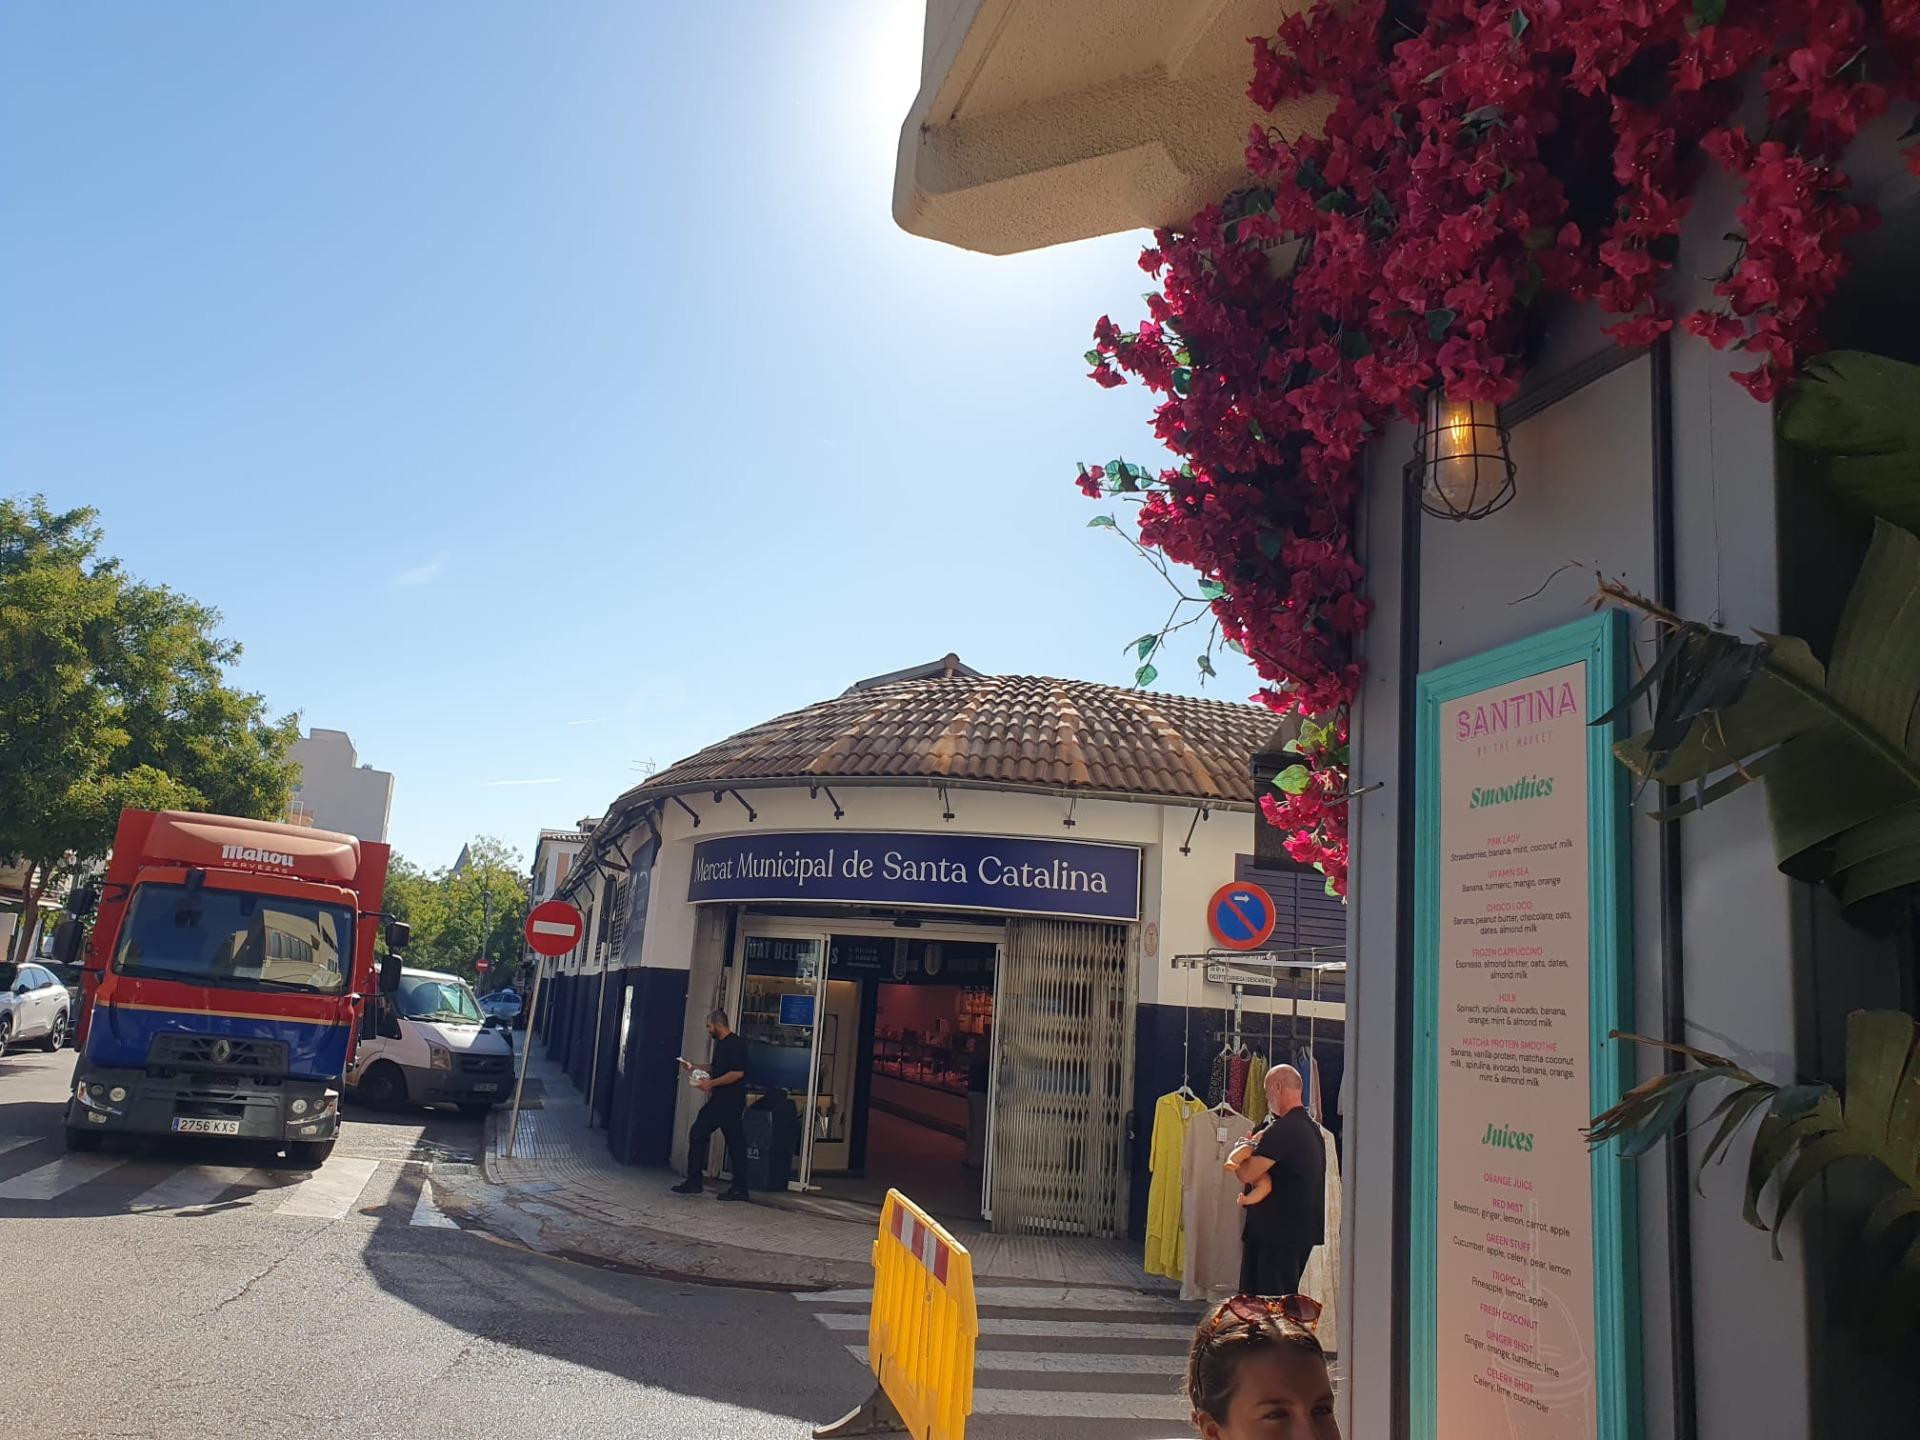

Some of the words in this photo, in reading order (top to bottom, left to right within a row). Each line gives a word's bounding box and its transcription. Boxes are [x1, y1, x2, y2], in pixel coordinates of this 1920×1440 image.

[1457, 681, 1577, 742] SANTINA
[1470, 774, 1554, 809] Smoothies
[1487, 837, 1502, 846] PINK
[1503, 833, 1520, 845] LADY
[1530, 841, 1557, 852] coconut
[1559, 838, 1573, 848] milk
[222, 845, 294, 867] Mahou
[224, 861, 288, 873] CERVEZAS
[693, 856, 732, 882] Mercat
[736, 849, 835, 887] Municipal
[842, 849, 873, 879] de
[882, 852, 968, 883] Santa
[978, 855, 1107, 894] Catalina
[1488, 869, 1514, 878] VITAMIN
[1516, 867, 1529, 876] SEA
[1538, 876, 1561, 887] orange
[1487, 902, 1511, 912] CHOCO
[1512, 901, 1532, 911] LOCO
[1476, 915, 1496, 925] peanut
[1500, 924, 1523, 934] almond
[1524, 923, 1537, 933] milk
[1472, 948, 1496, 958] FROZEN
[1498, 947, 1543, 957] CAPPUCCINO
[1484, 960, 1506, 968] almond
[1490, 971, 1513, 980] almond
[1515, 970, 1528, 979] milk
[1499, 993, 1517, 1001] HULK
[1491, 1016, 1505, 1025] mint
[1507, 1017, 1511, 1025] &
[1513, 1017, 1537, 1026] almond
[1539, 1018, 1552, 1027] milk
[1463, 1038, 1489, 1047] MATCHA
[1490, 1039, 1518, 1049] PROTEIN
[1520, 1040, 1558, 1051] SMOOTHIE
[1474, 1050, 1492, 1059] vanilla
[1519, 1053, 1543, 1062] matcha
[1546, 1055, 1574, 1065] coconut
[1479, 1073, 1492, 1082] mint
[1494, 1074, 1499, 1082] &
[1501, 1075, 1524, 1085] almond
[1526, 1077, 1539, 1086] milk
[180, 1120, 210, 1131] 2756
[214, 1120, 237, 1132] KXS
[1482, 1123, 1534, 1152] Juices
[1484, 1173, 1511, 1186] ORANGE
[1514, 1178, 1533, 1191] JUICE
[1492, 1199, 1505, 1210] RED
[1507, 1202, 1524, 1212] MIST
[1550, 1226, 1570, 1237] apple
[1486, 1233, 1508, 1245] GREEN
[1510, 1237, 1531, 1251] STUFF
[1550, 1262, 1571, 1276] lemon
[1492, 1270, 1526, 1288] TROPICAL
[1529, 1295, 1548, 1308] apple
[1480, 1303, 1500, 1319] FRESH
[1502, 1312, 1538, 1329] COCONUT
[1487, 1330, 1513, 1346] GINGER
[1514, 1339, 1533, 1353] SHOT
[1545, 1362, 1560, 1378] lime
[1487, 1367, 1513, 1385] CELERY
[1514, 1378, 1534, 1393] SHOT
[1514, 1392, 1550, 1413] cucumber
